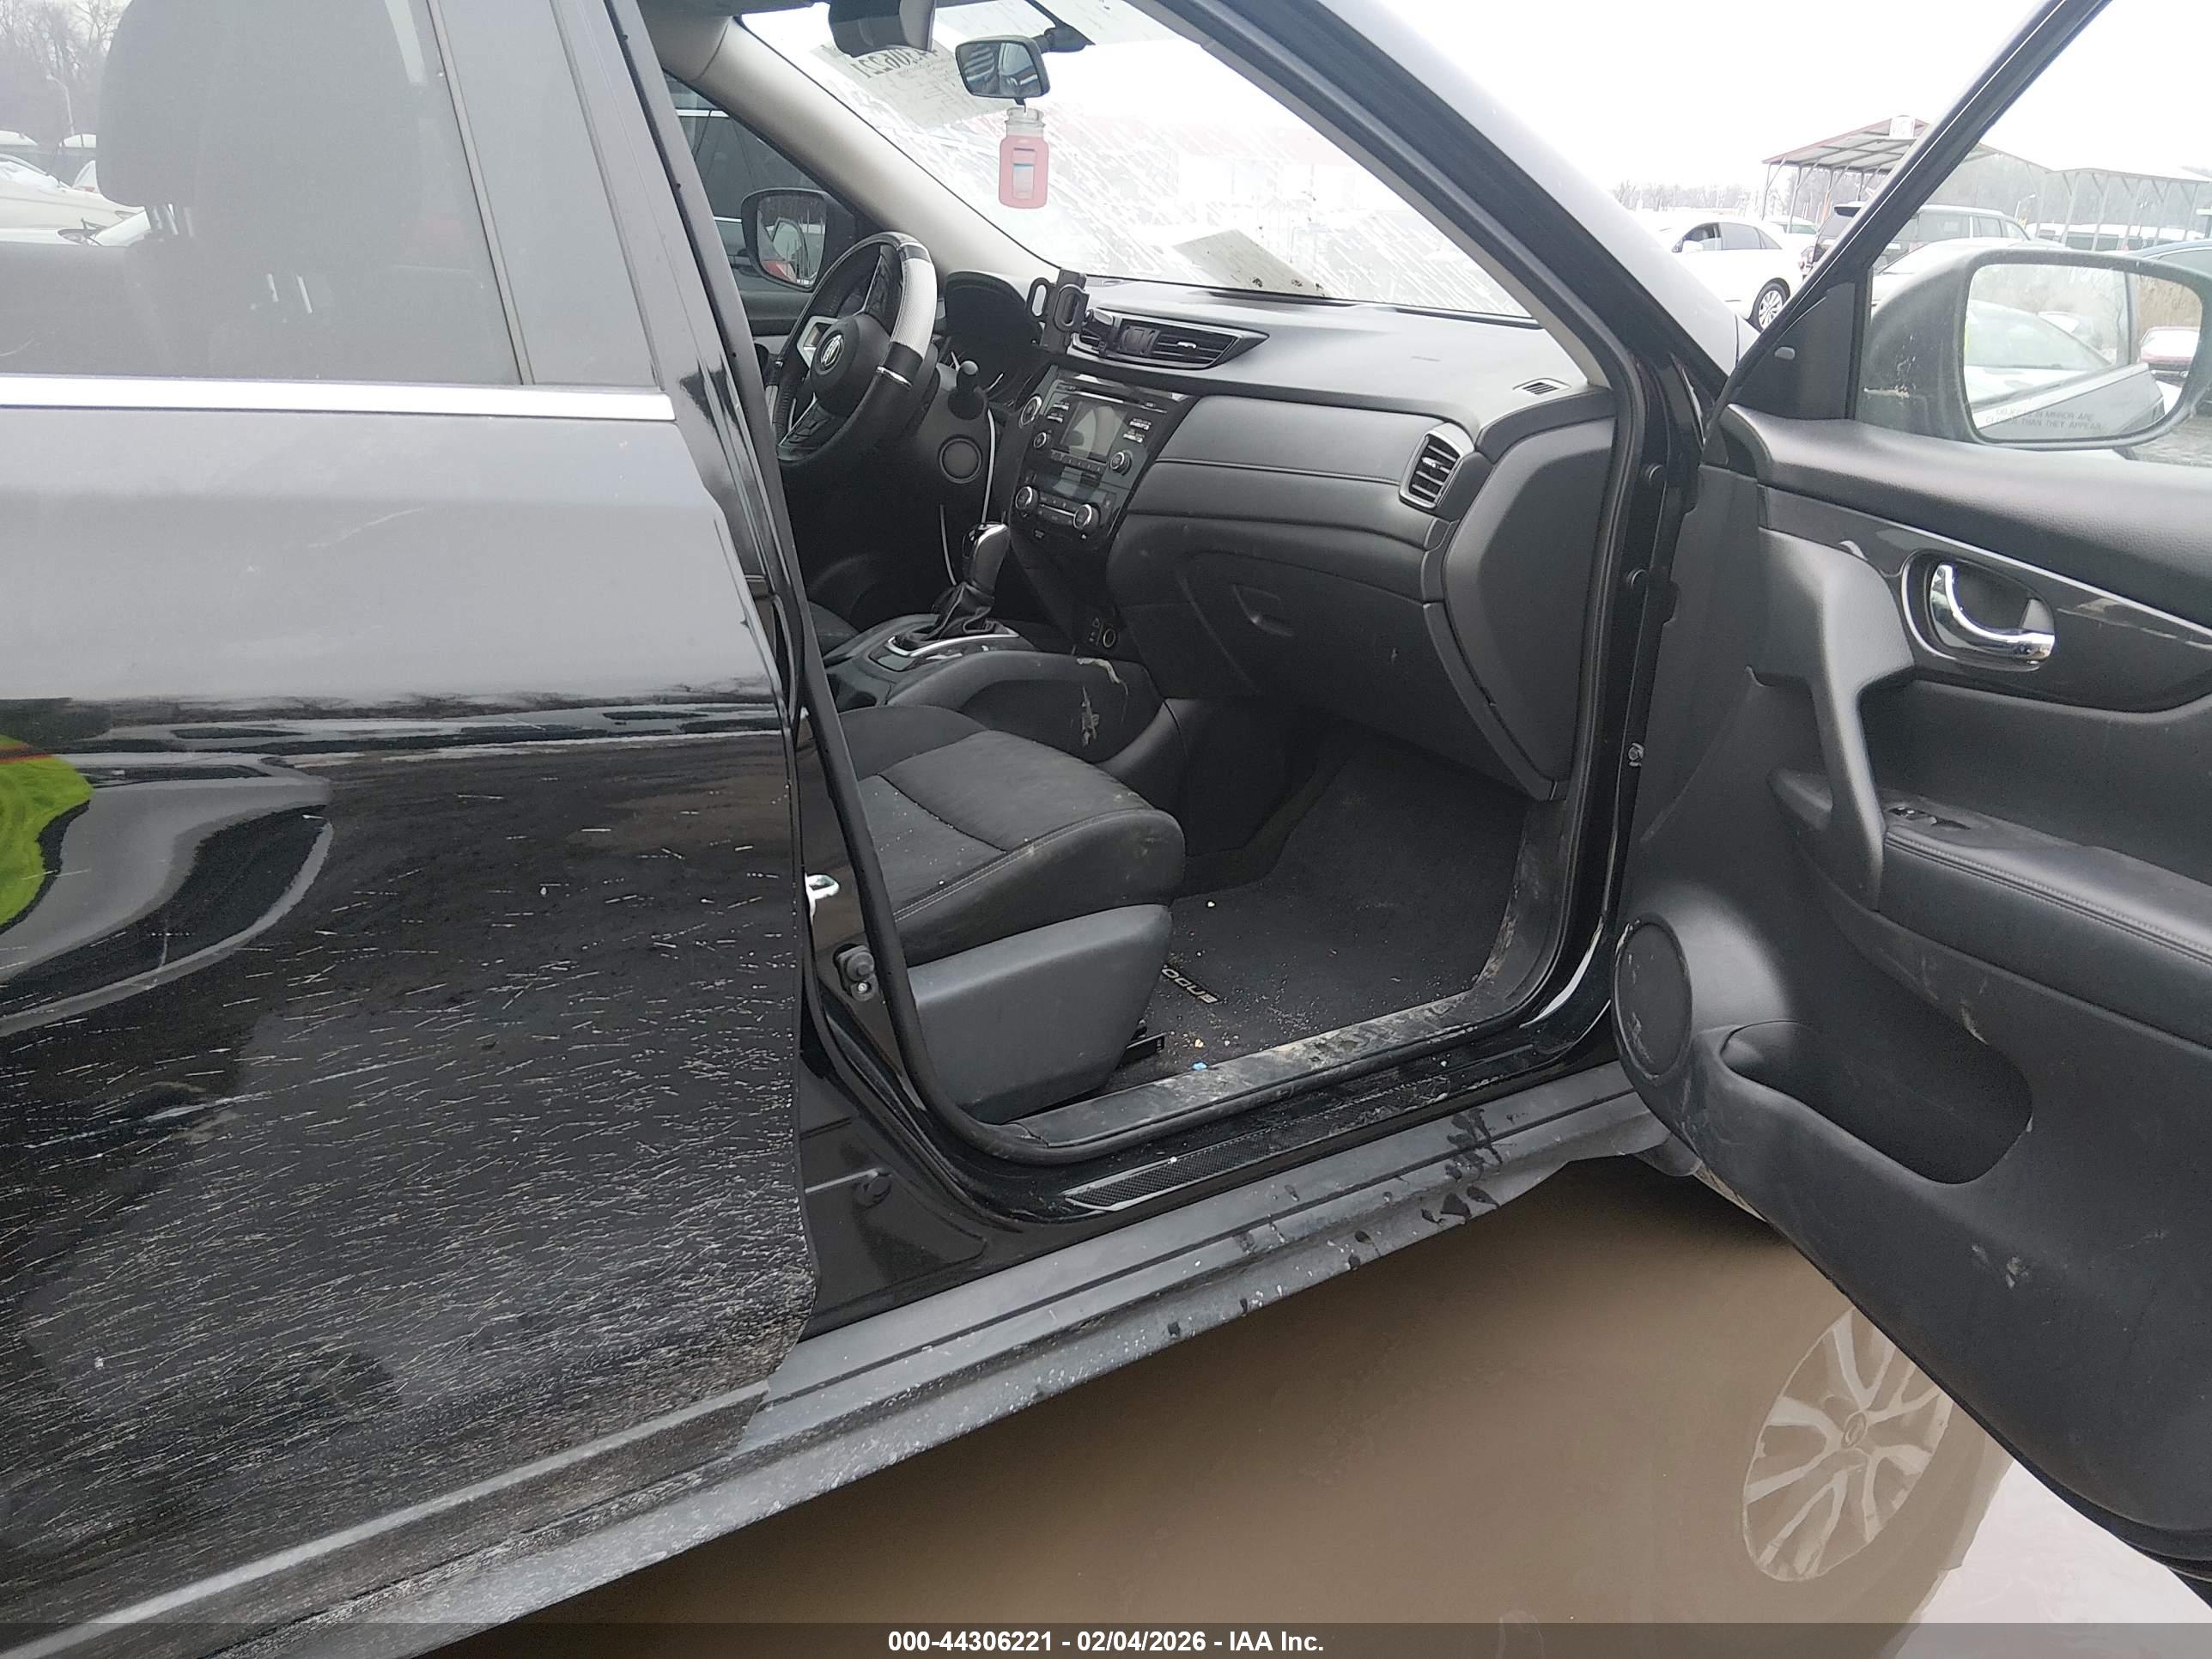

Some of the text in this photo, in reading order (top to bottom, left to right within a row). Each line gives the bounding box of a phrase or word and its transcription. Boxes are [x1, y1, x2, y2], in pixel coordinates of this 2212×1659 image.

[2045, 411, 2075, 420] MIRROR
[2021, 417, 2042, 427] THAN
[2046, 419, 2065, 428] THEY
[1161, 964, 1218, 1003] OGUE
